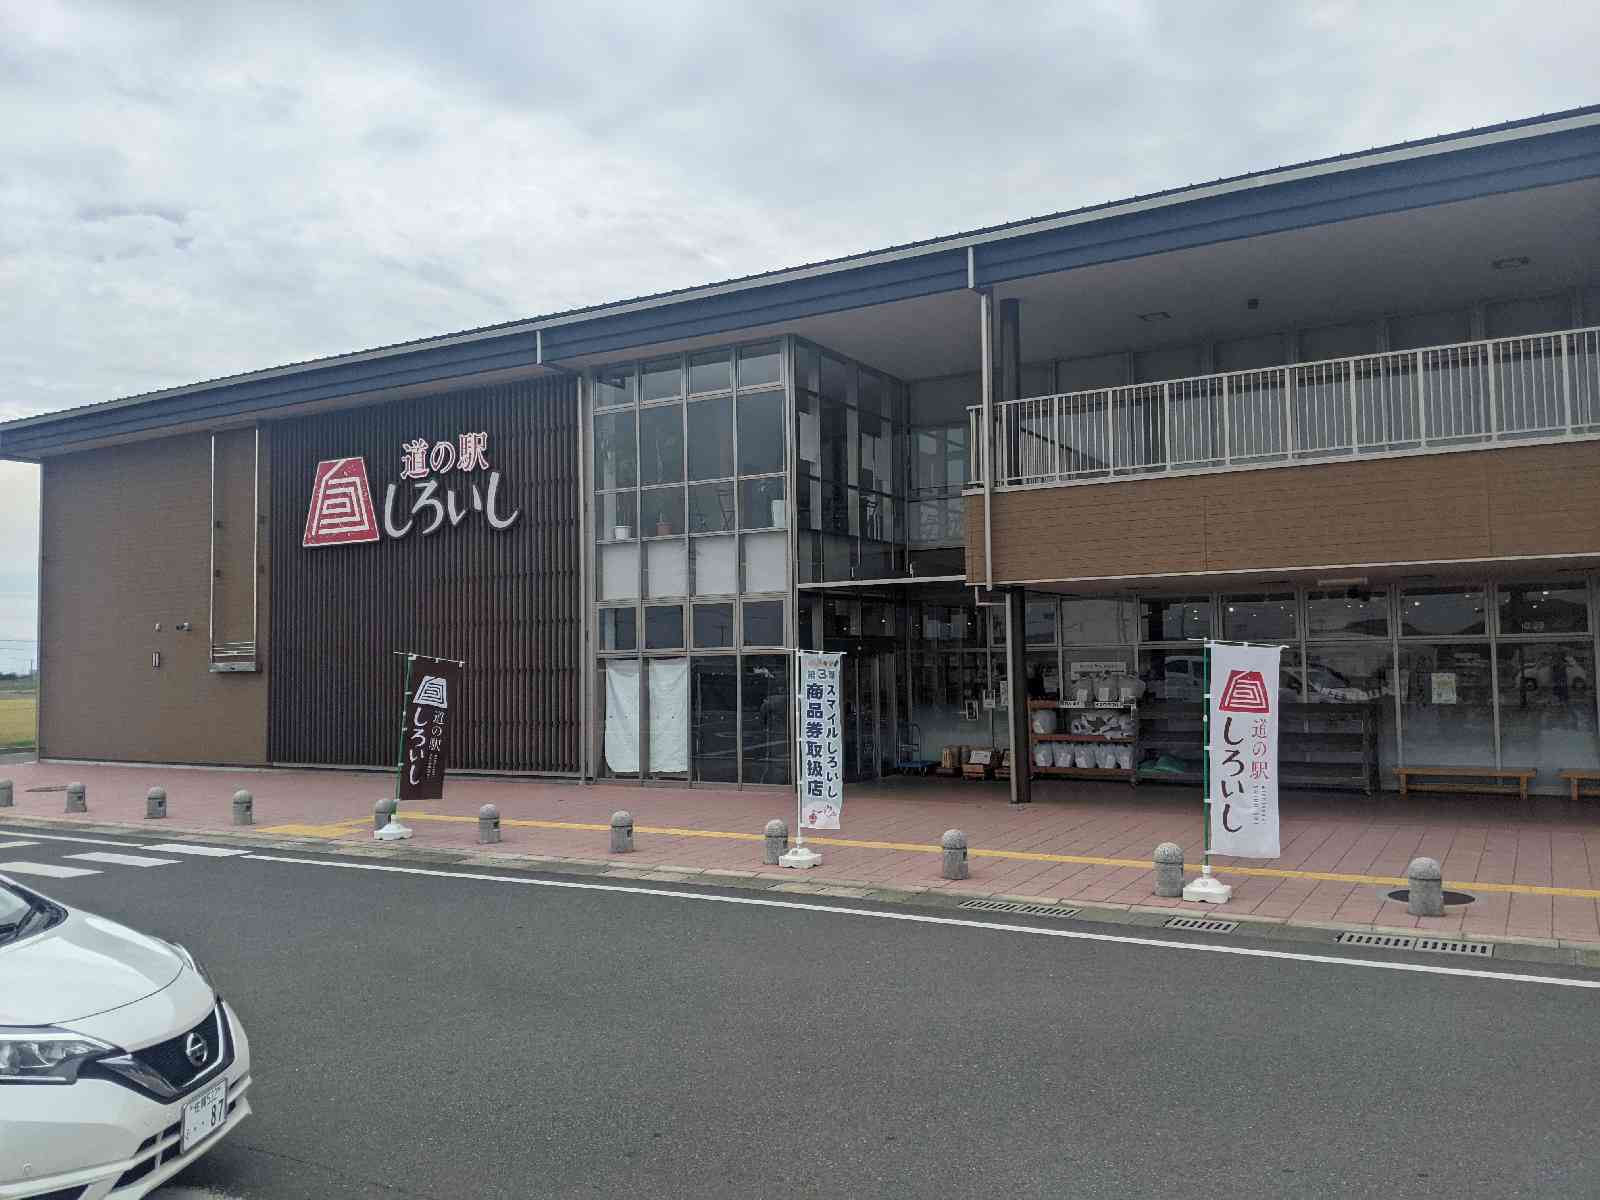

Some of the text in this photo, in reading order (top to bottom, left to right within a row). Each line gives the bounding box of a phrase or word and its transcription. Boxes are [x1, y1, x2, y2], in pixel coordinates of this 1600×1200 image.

[400, 431, 490, 480] 道の駅
[384, 471, 520, 540] しろいし
[409, 707, 428, 785] しろいし
[428, 710, 446, 752] 道の駅
[806, 683, 824, 798] 商品券取扱店
[826, 684, 839, 799] スマイルしろいし
[1249, 719, 1270, 780] 道の駅
[1220, 716, 1245, 833] しろいし
